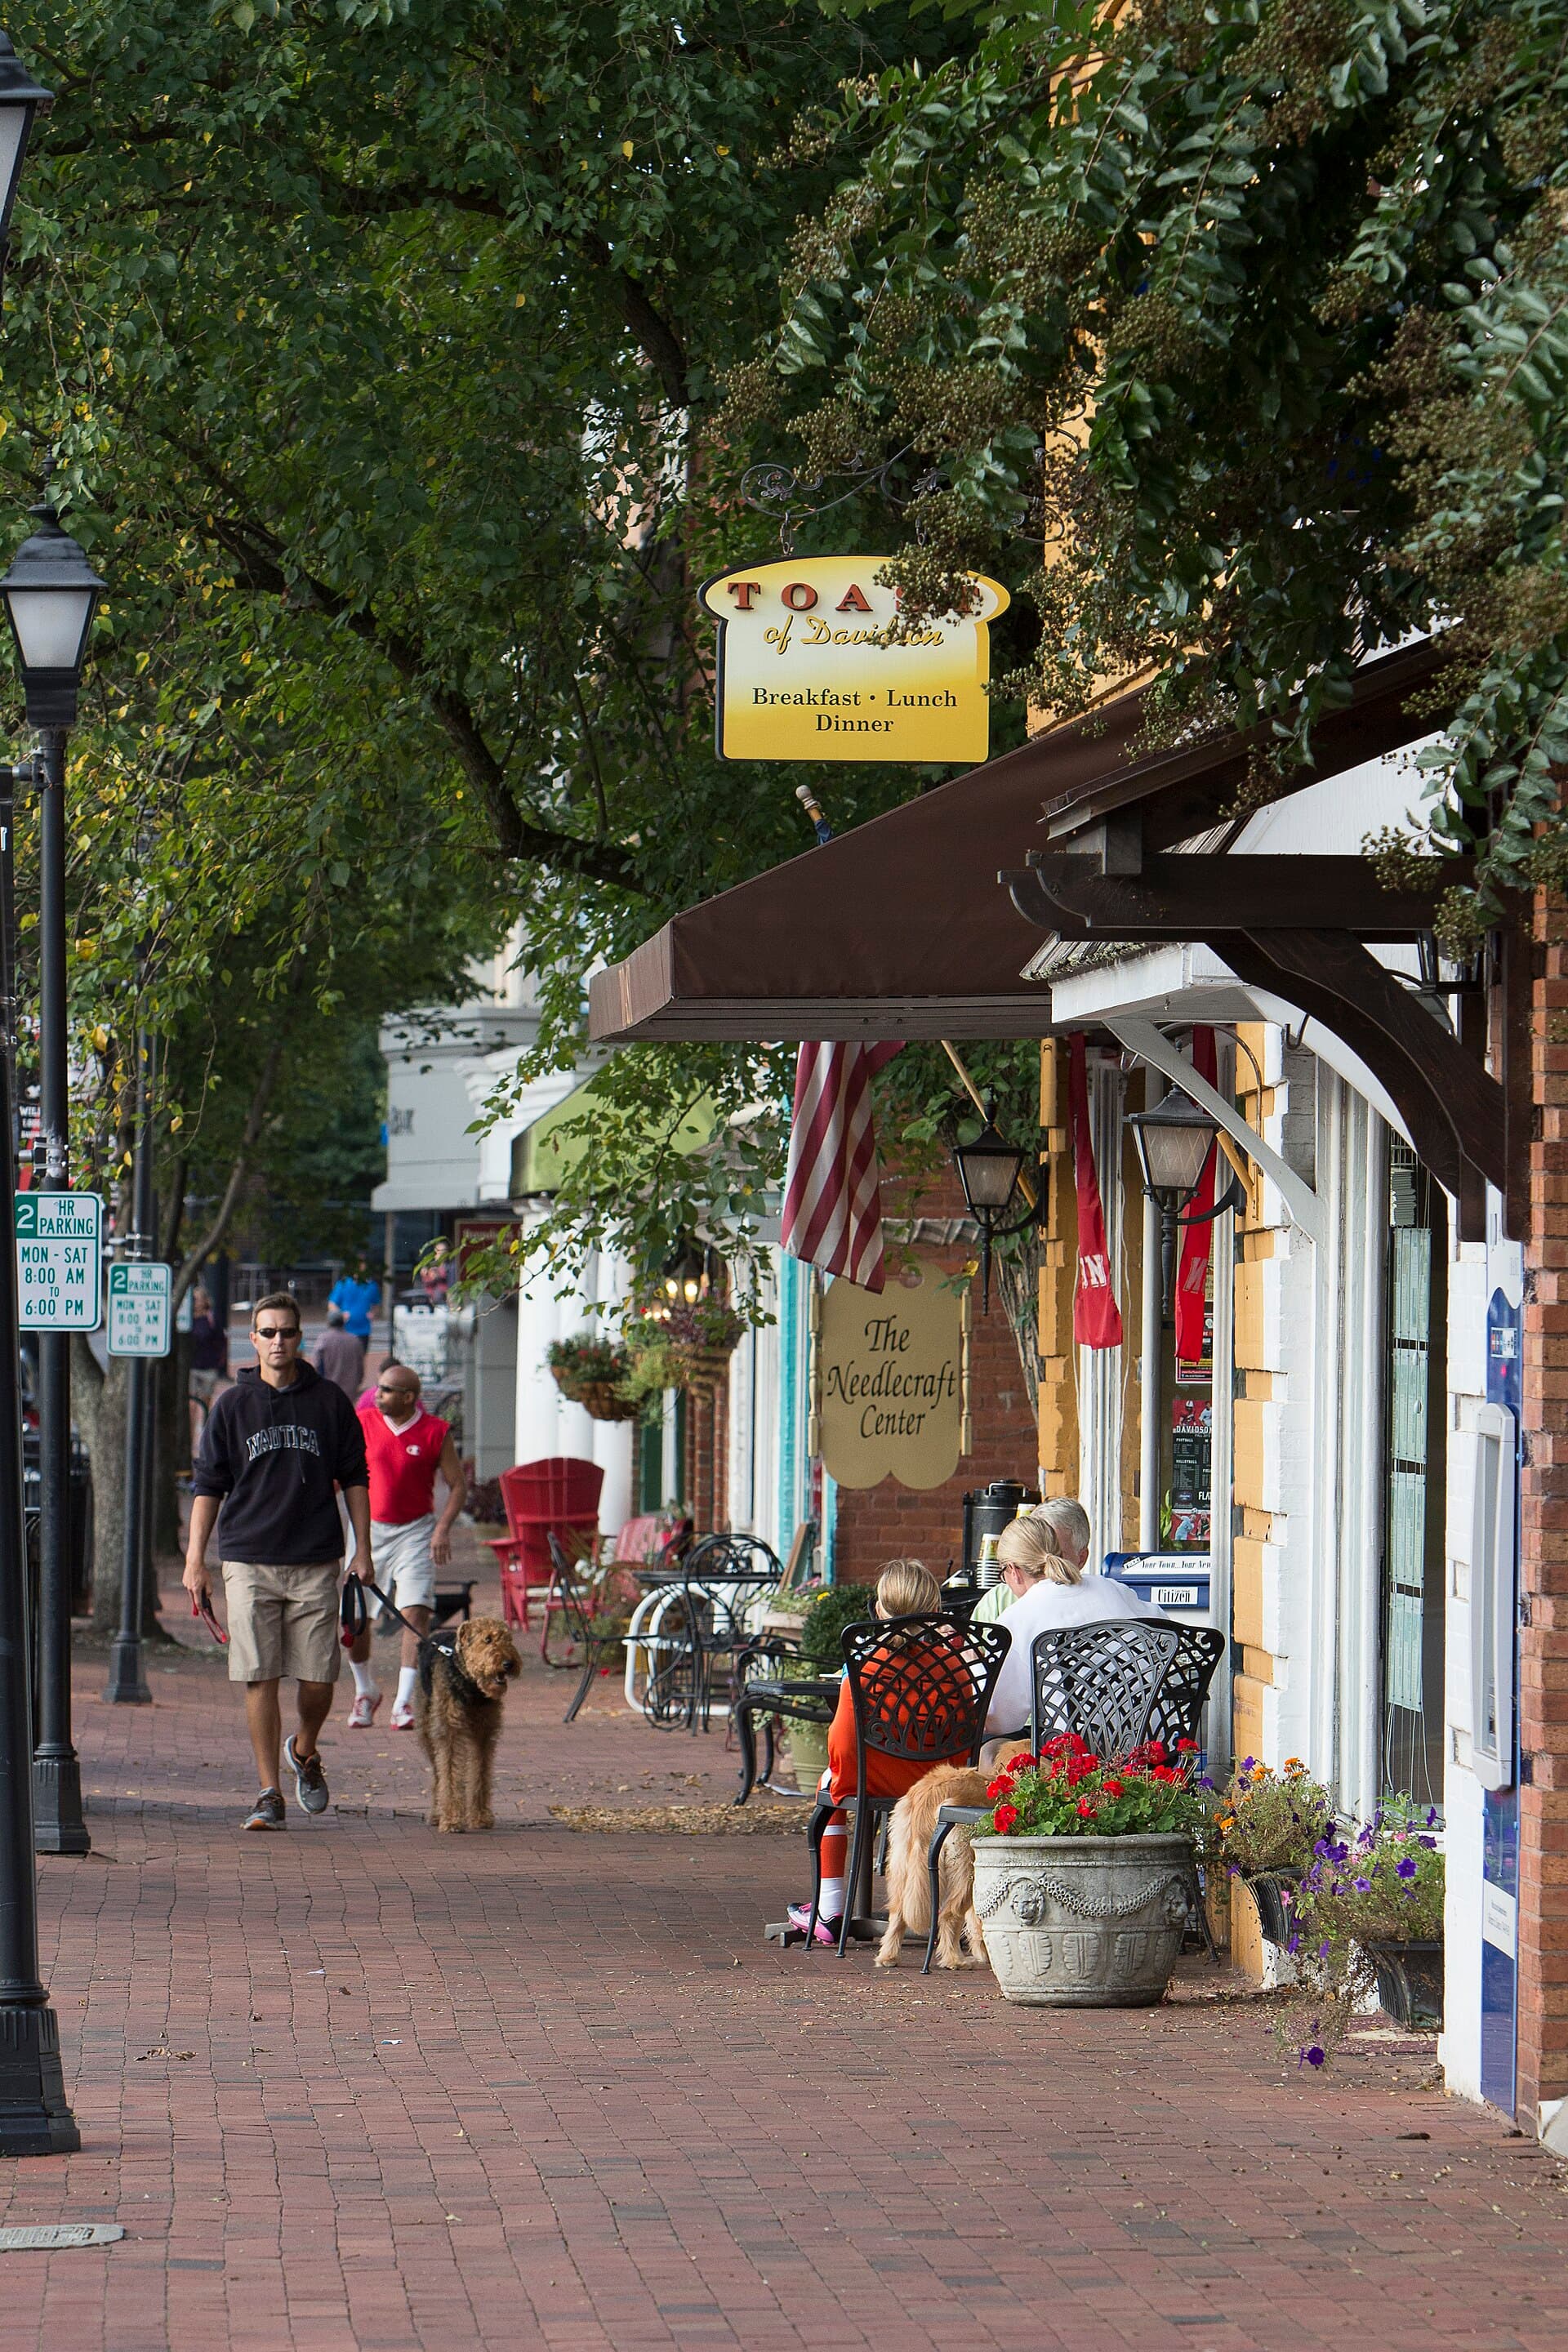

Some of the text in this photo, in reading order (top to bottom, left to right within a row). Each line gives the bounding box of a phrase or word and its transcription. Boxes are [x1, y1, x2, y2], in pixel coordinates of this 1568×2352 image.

[763, 613, 794, 655] of
[751, 688, 958, 707] Breakfast Lunch
[815, 714, 894, 733] Dinner
[16, 1204, 34, 1229] 2
[59, 1200, 75, 1216] HR
[39, 1218, 94, 1235] PARKING
[21, 1246, 49, 1263] MON
[64, 1247, 88, 1264] SAT
[24, 1267, 85, 1285] 8:00 AM
[114, 1271, 126, 1289] 2
[141, 1269, 152, 1279] HR
[50, 1286, 60, 1297] TO
[129, 1281, 164, 1291] PARKING
[25, 1299, 83, 1316] 6:00 PM
[117, 1300, 135, 1309] MON
[145, 1300, 161, 1310] SAT
[145, 1313, 158, 1324] AM
[145, 1334, 158, 1345] PM
[864, 1314, 911, 1352] The
[826, 1360, 956, 1410] Needlecraft
[860, 1404, 926, 1438] Center
[246, 1425, 320, 1462] NAUTICA
[1142, 1561, 1156, 1569] Your
[1158, 1588, 1190, 1603] Citizen
